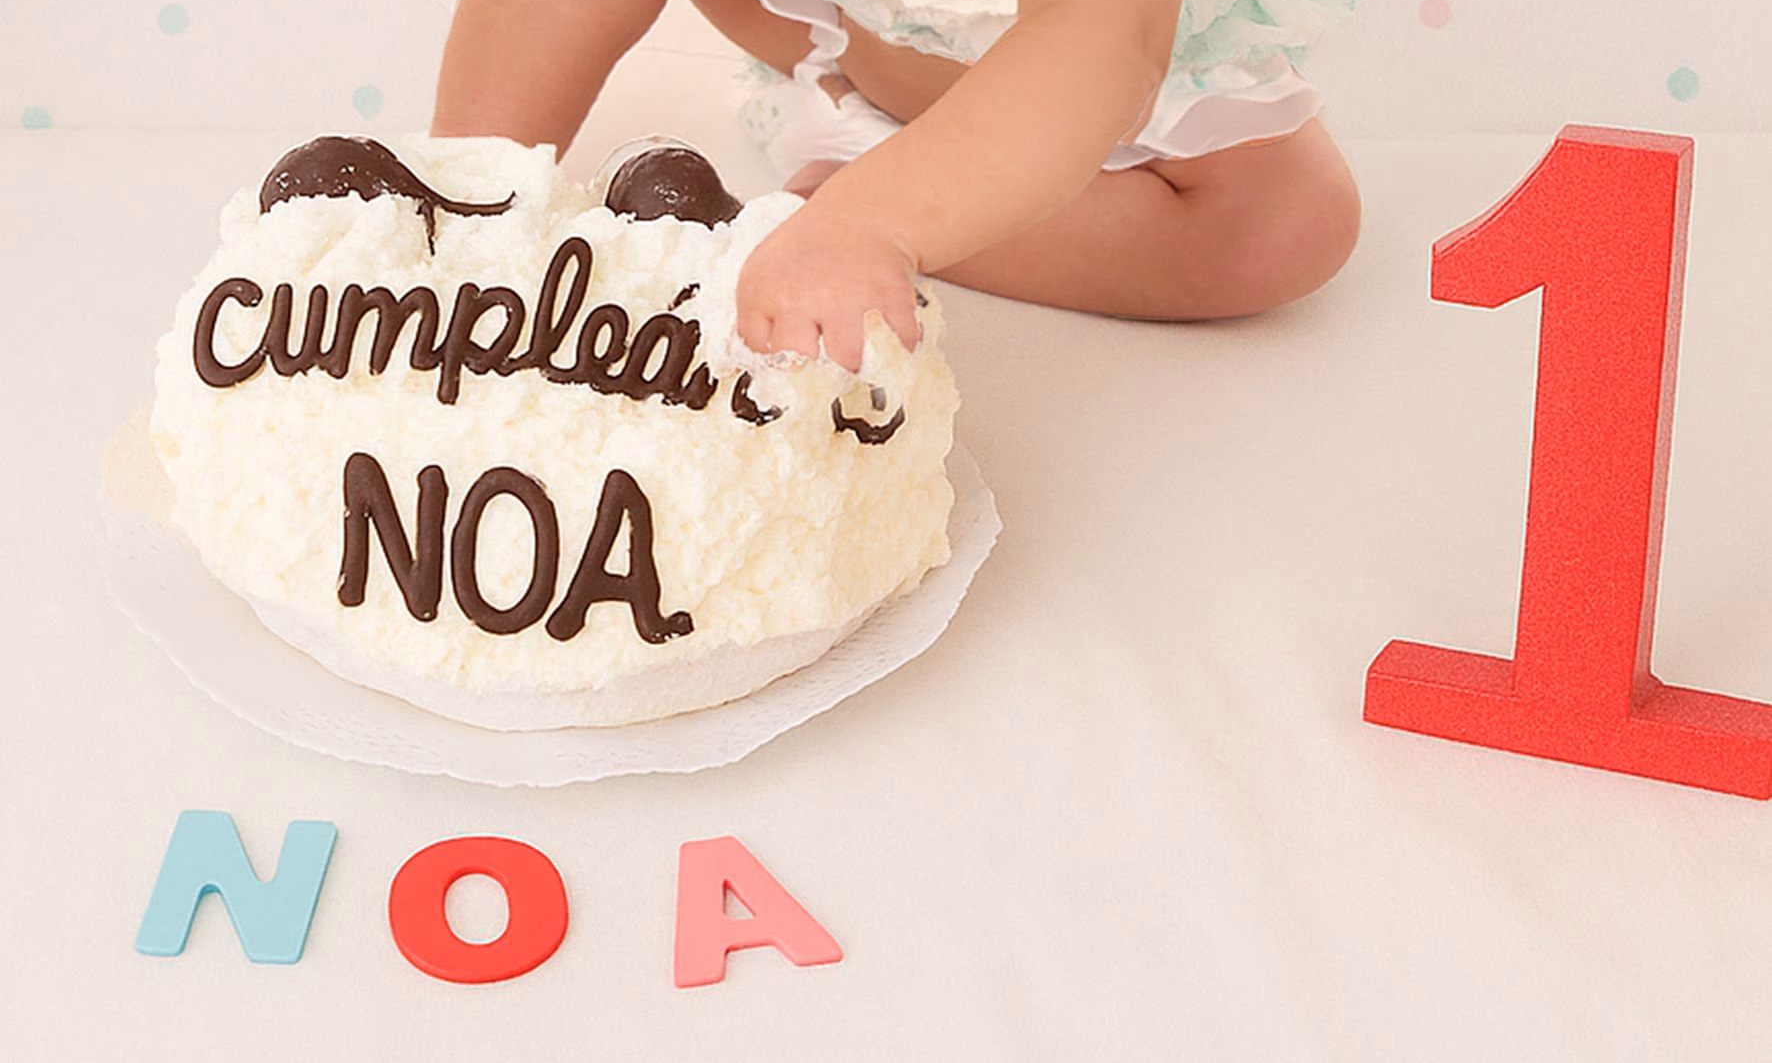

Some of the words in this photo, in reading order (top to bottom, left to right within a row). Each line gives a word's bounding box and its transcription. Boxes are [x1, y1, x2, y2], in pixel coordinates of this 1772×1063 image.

[337, 452, 695, 645] NOA
[1363, 124, 1772, 800] 1
[135, 810, 843, 989] NOA
